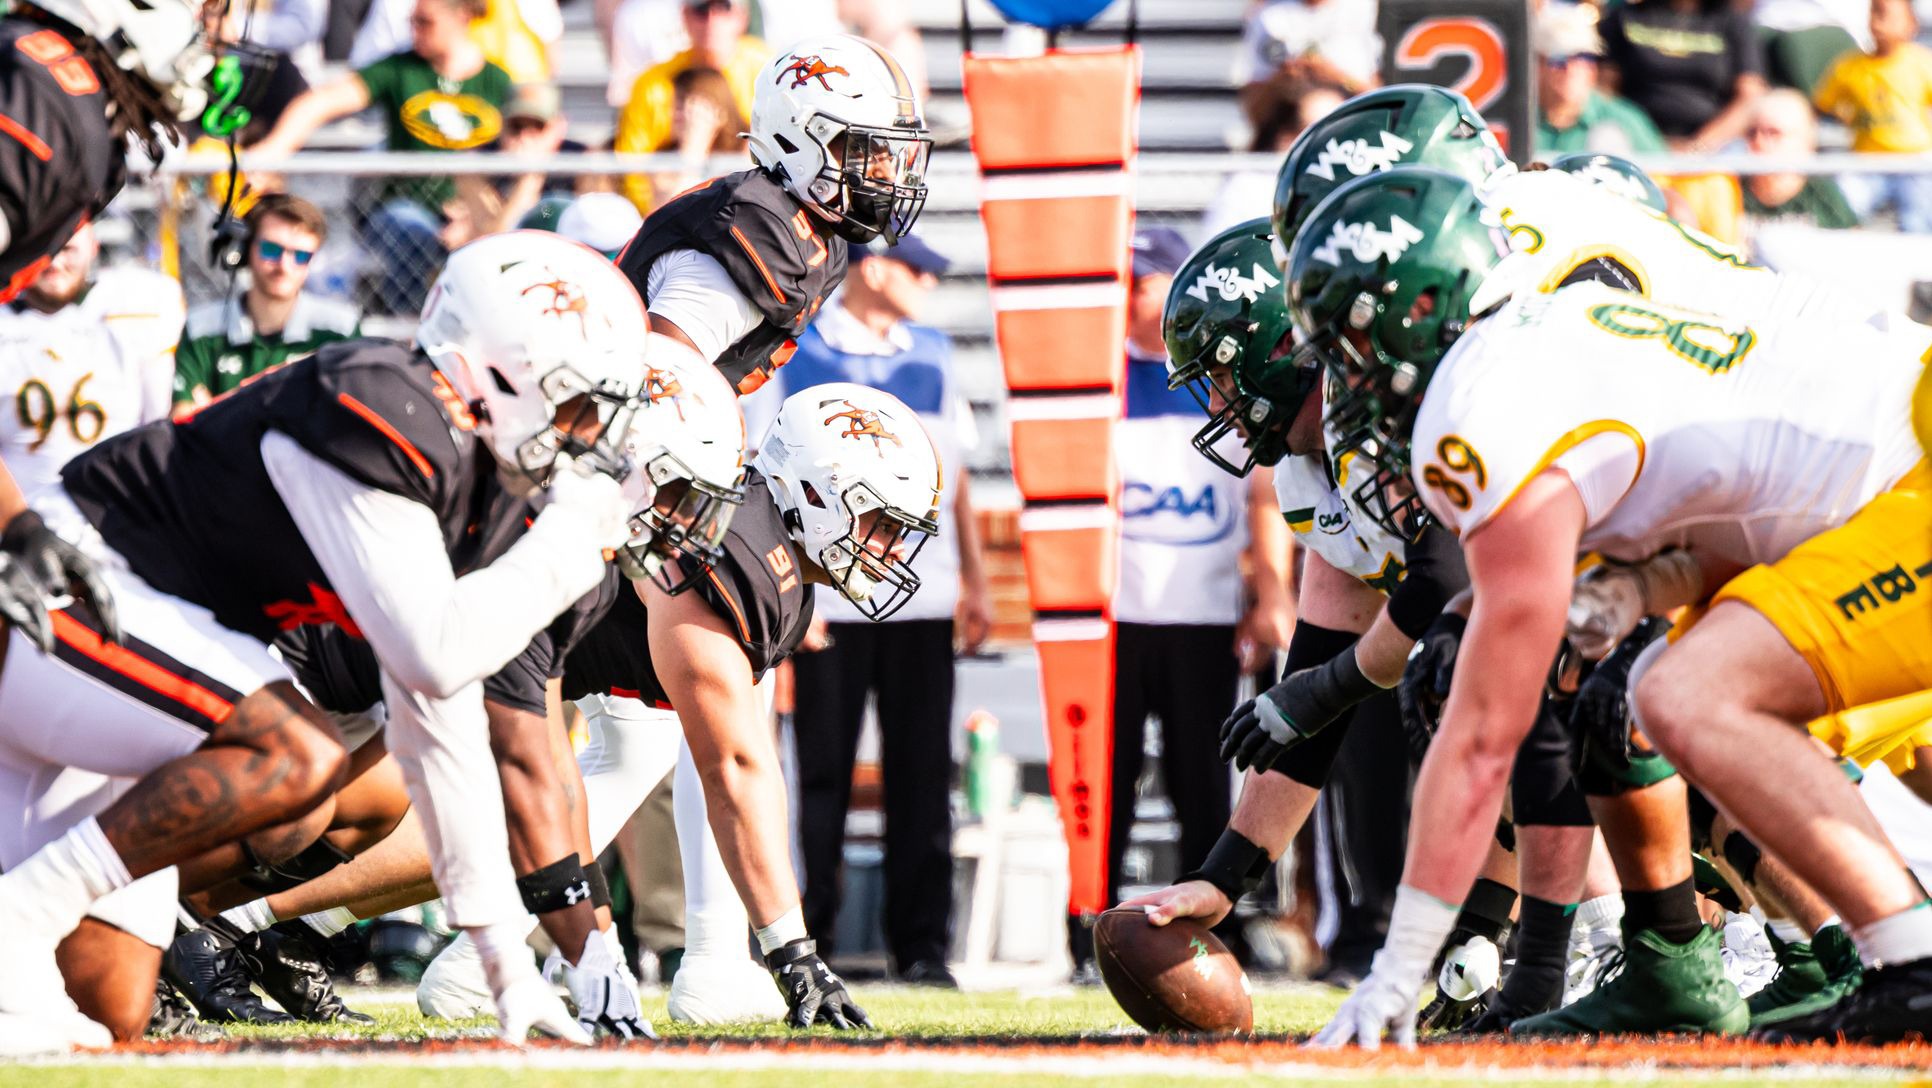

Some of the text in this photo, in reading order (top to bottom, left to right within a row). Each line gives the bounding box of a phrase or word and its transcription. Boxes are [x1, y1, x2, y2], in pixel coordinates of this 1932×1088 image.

[1395, 16, 1509, 154] 2
[1306, 130, 1414, 181] W&M
[791, 209, 828, 268] 57
[1312, 214, 1425, 267] W&M
[1185, 262, 1281, 303] W&M
[16, 372, 107, 454] 96
[1422, 433, 1488, 512] 89
[1123, 483, 1216, 523] CAA
[1317, 510, 1343, 529] CAA
[765, 543, 798, 594] 91
